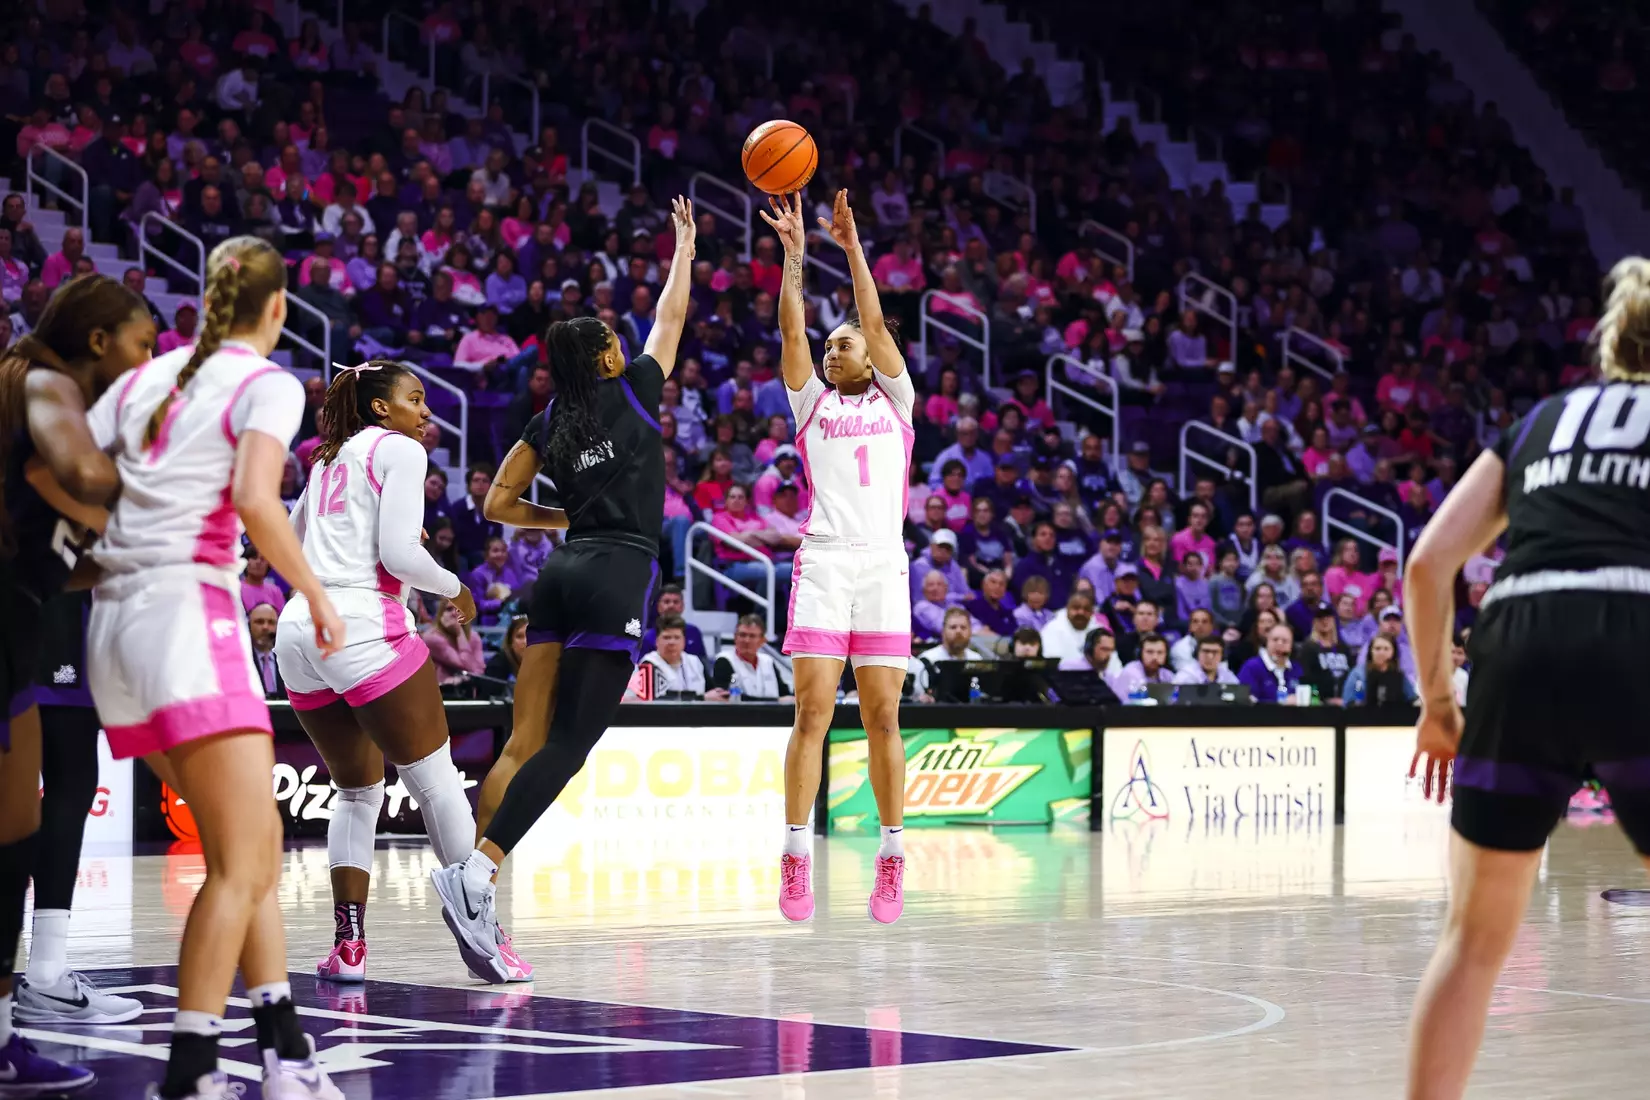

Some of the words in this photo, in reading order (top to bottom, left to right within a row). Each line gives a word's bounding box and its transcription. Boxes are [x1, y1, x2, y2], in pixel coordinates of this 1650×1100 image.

[819, 415, 893, 440] Wildcats
[1548, 384, 1650, 453] 10
[854, 445, 870, 487] 1
[317, 463, 348, 517] 12
[1183, 737, 1317, 768] Ascension
[1184, 784, 1226, 816] Via
[1235, 783, 1322, 816] Christi
